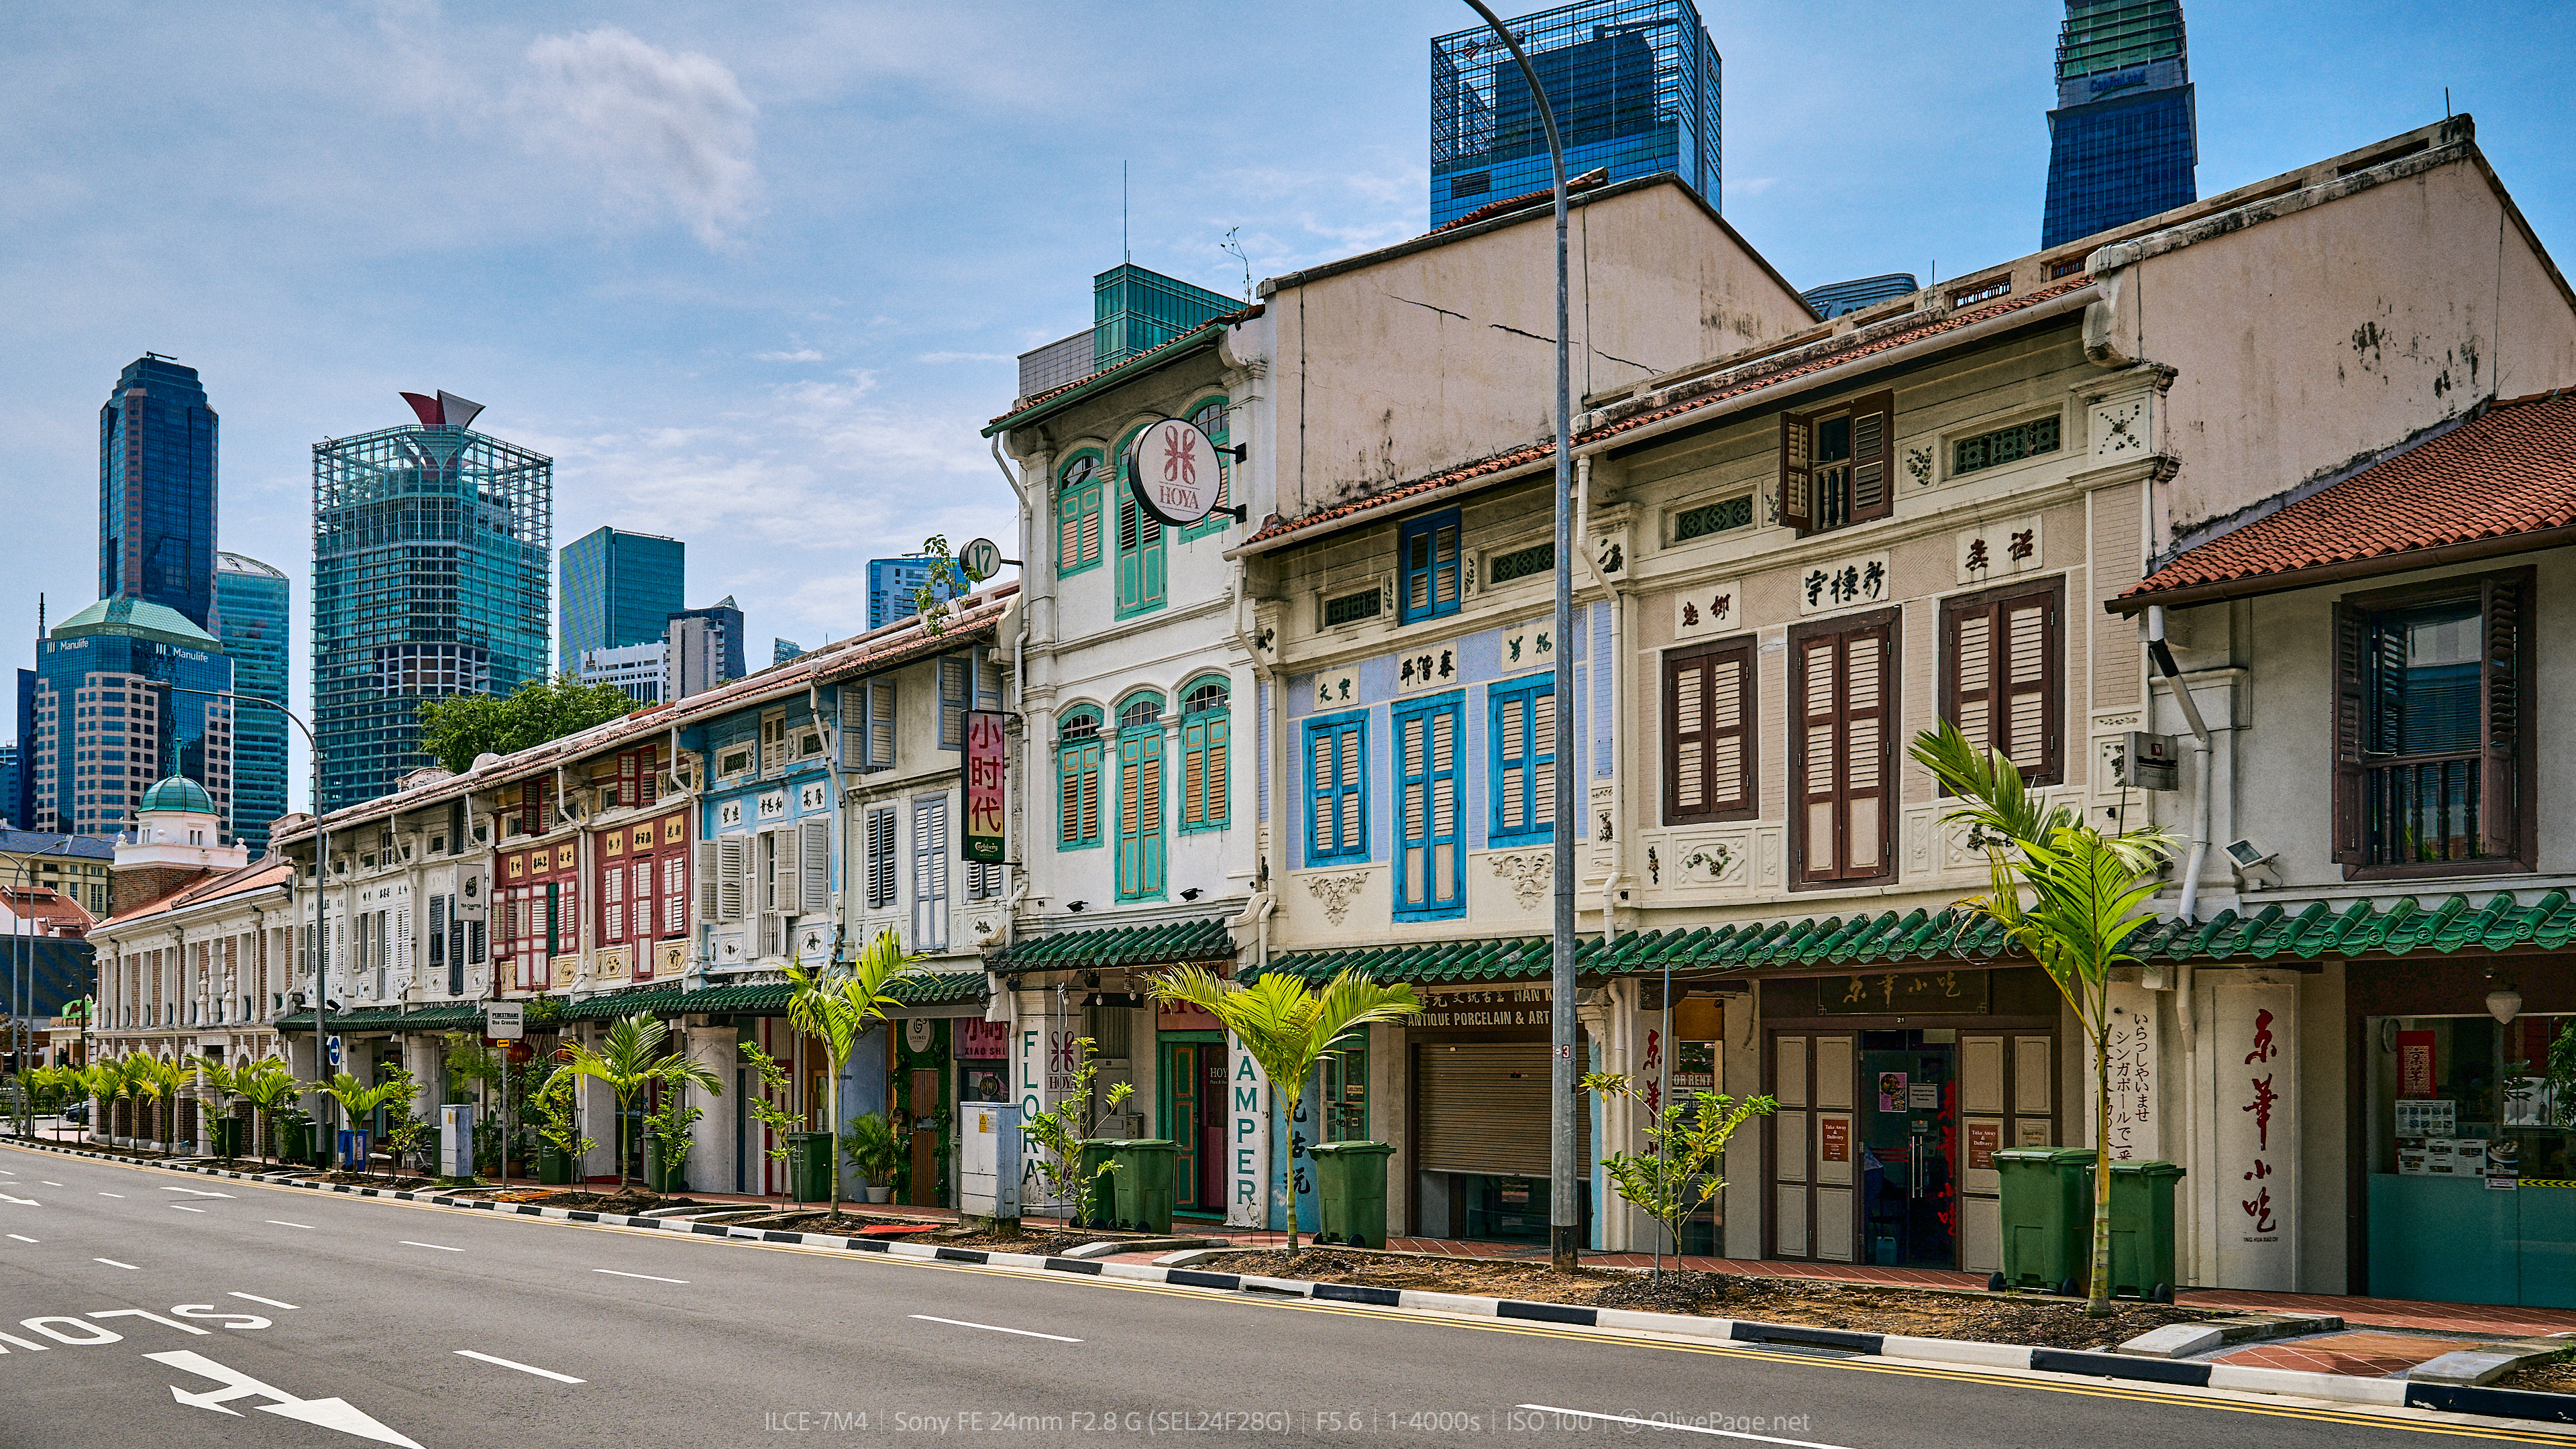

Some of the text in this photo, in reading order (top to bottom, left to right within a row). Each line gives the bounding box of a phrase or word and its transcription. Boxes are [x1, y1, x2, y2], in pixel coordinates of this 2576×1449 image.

[1485, 30, 1523, 46] FRARS
[2089, 68, 2146, 92] CapitaLand
[1159, 485, 1200, 509] HOYA
[974, 544, 991, 573] 17
[60, 638, 89, 651] Manulife
[173, 647, 209, 663] Manulife
[971, 715, 1001, 833] 小时代
[975, 841, 998, 853] Carlsberg
[1408, 1011, 1550, 1026] ANTIQUE PORCELAIN & ART
[965, 1047, 1006, 1055] XIAO SHI
[1562, 1045, 1570, 1058] 3
[1049, 1076, 1078, 1089] HOYA
[1672, 1074, 1711, 1085] OR RENT
[1022, 1030, 1040, 1185] FLORA
